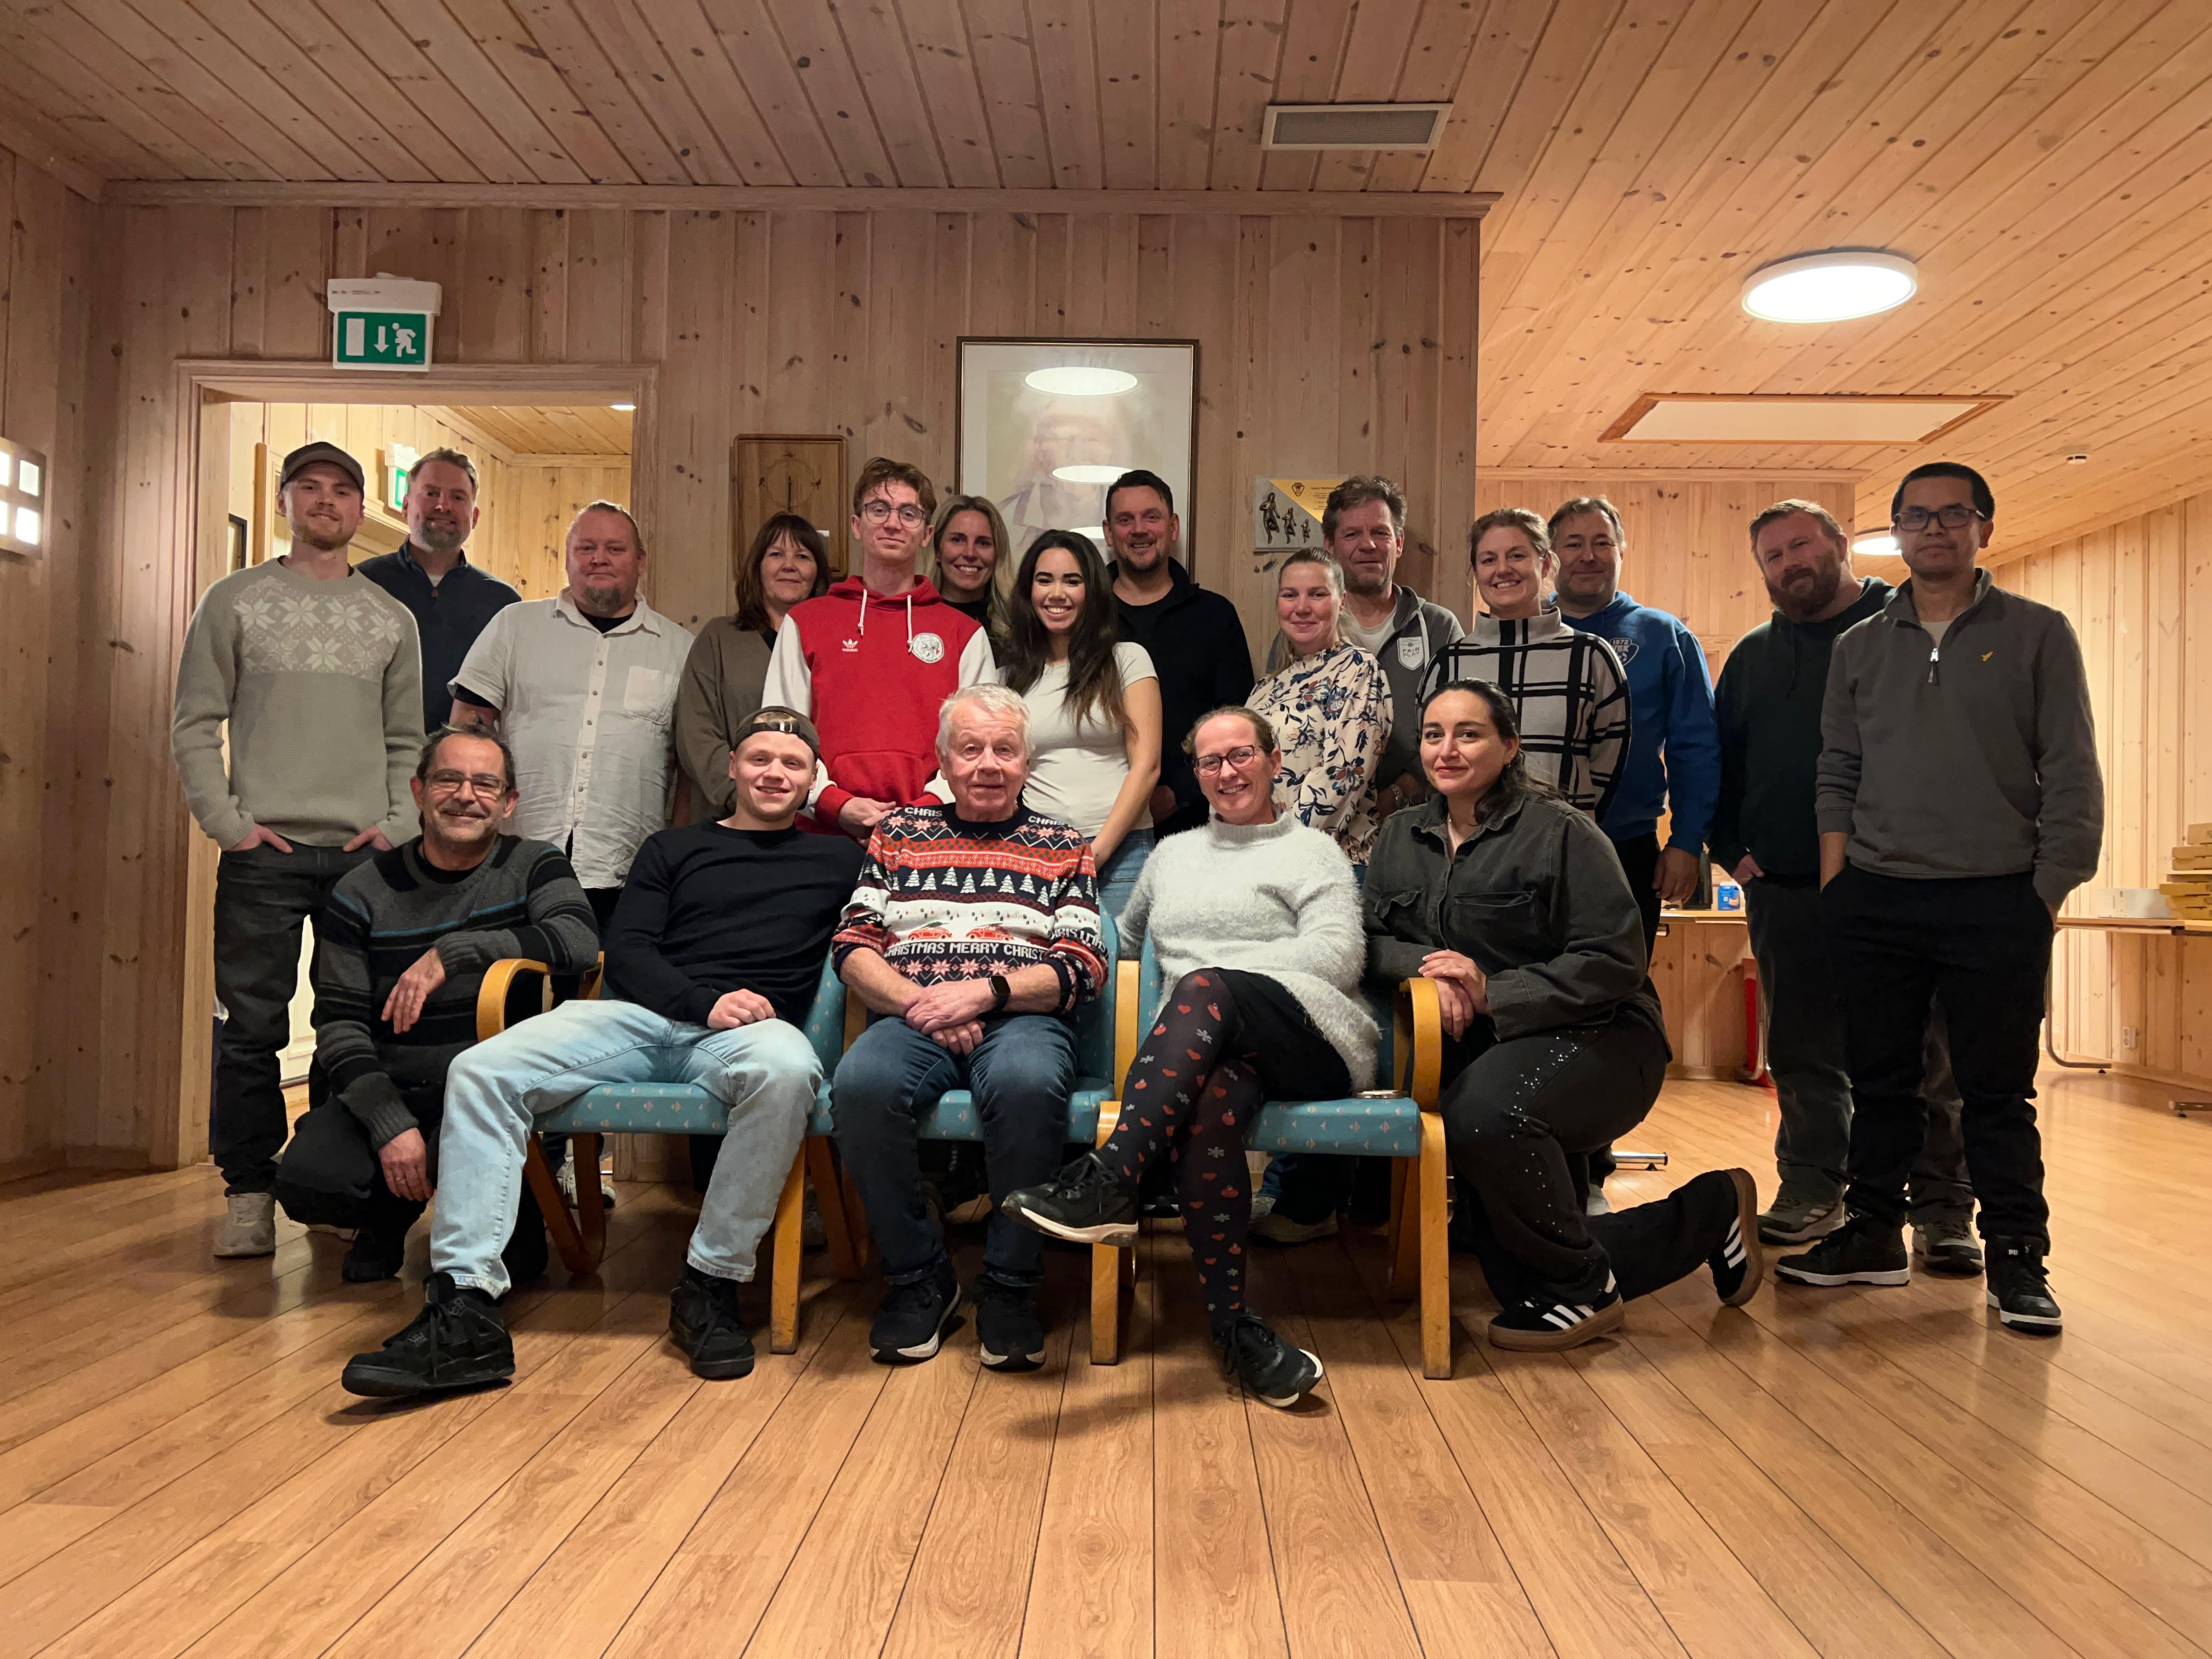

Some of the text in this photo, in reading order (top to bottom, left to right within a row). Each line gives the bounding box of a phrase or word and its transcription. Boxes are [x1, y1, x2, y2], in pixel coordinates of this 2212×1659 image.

[904, 807, 943, 817] CHRIS
[949, 943, 999, 954] MERRY
[1003, 944, 1045, 961] CHRIST
